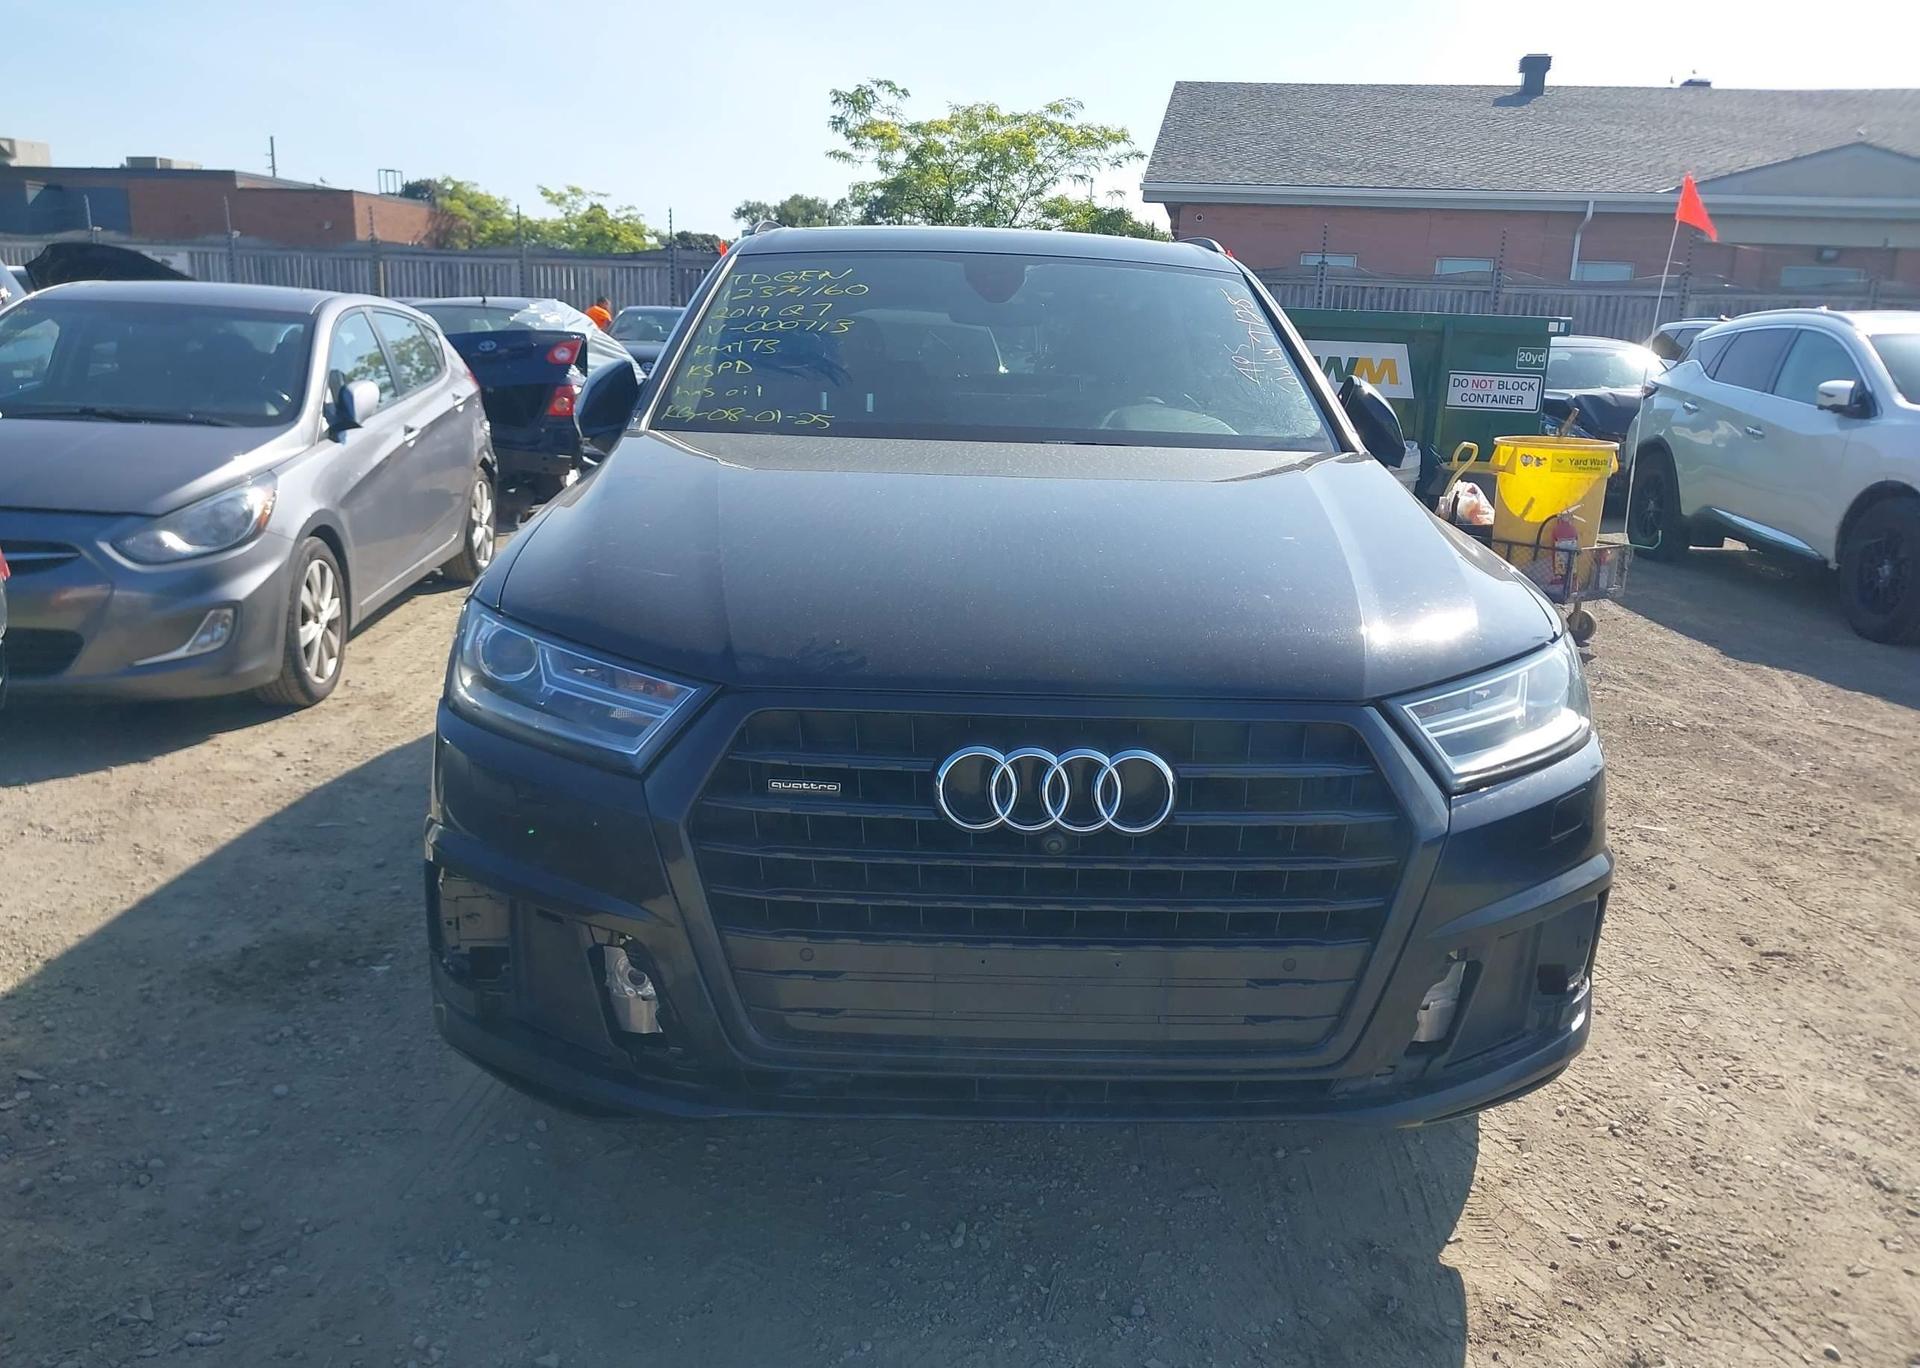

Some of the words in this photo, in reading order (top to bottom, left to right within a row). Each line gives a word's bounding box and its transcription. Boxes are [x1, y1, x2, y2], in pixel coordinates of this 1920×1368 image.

[1518, 351, 1545, 364] 20yd
[1452, 378, 1469, 388] DO
[1471, 379, 1495, 390] NOT
[1497, 380, 1536, 392] BLOCK
[1460, 392, 1524, 405] CONTAINER
[1569, 457, 1588, 467] Yard
[771, 781, 837, 790] quattro
